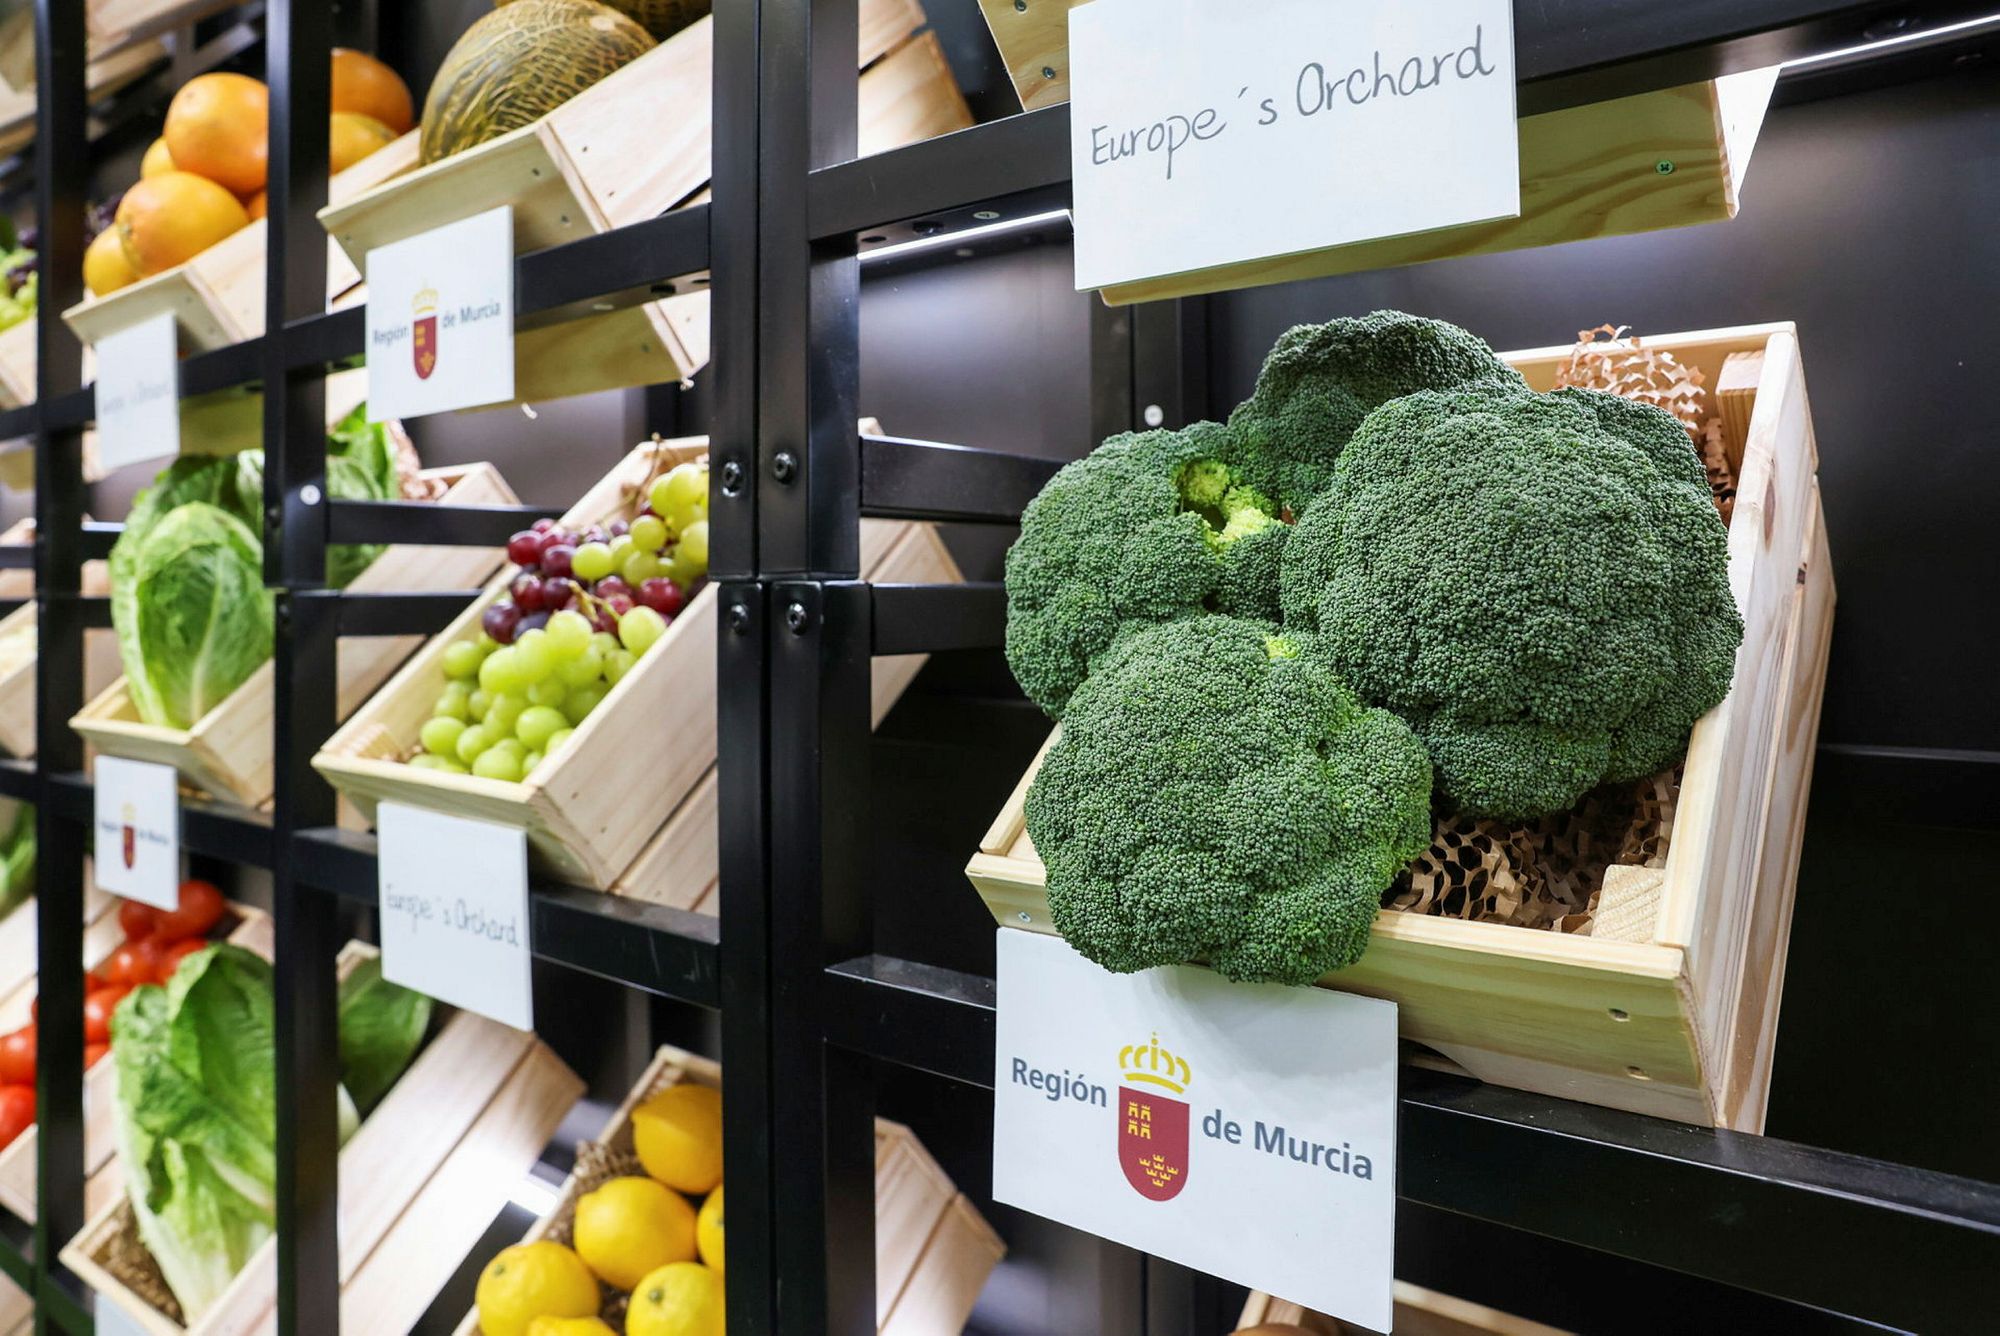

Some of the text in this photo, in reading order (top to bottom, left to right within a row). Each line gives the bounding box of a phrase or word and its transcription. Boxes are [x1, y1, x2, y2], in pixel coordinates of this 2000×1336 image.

[1296, 24, 1495, 117] Orchard
[442, 312, 455, 330] de
[459, 300, 500, 324] Murcia
[1011, 1056, 1374, 1181] Región de Murcia
